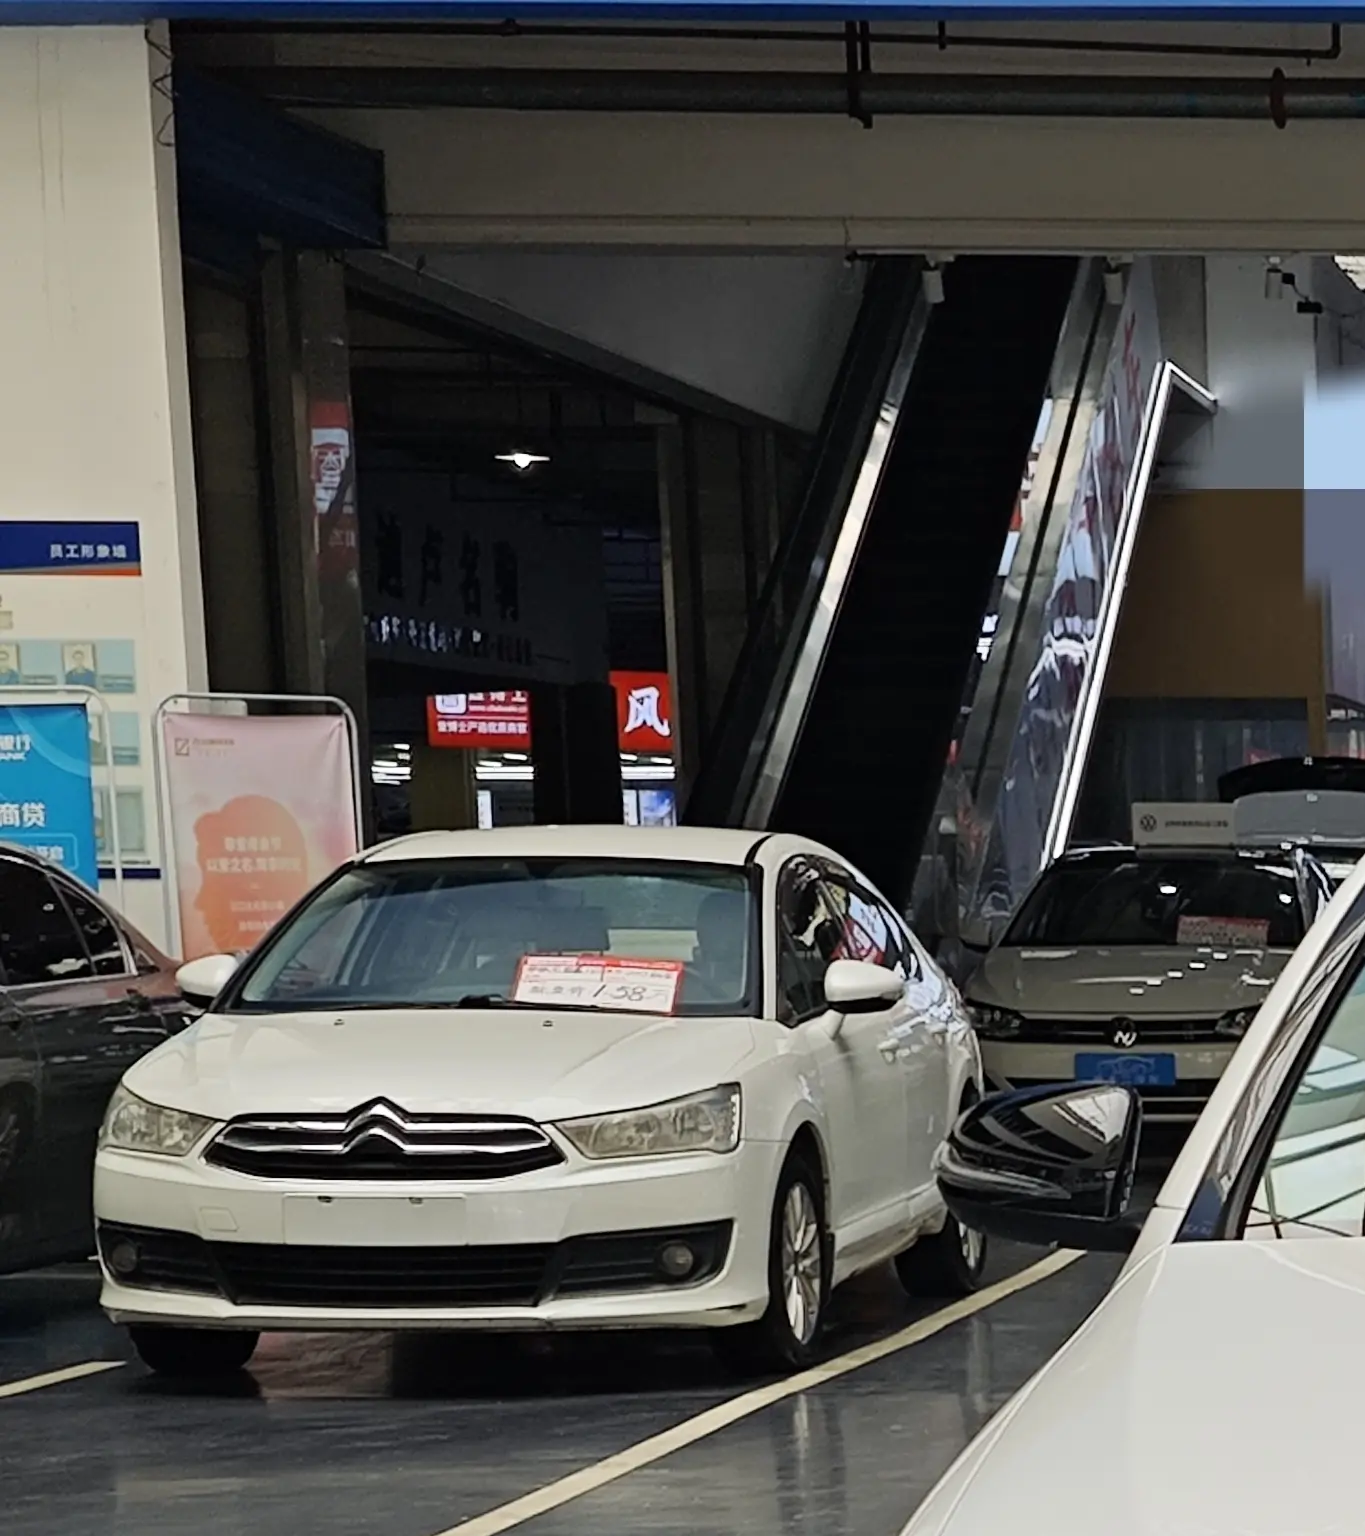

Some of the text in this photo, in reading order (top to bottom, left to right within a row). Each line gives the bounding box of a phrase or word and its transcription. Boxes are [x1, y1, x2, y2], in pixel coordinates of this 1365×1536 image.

[50, 543, 127, 559] 员工形象墙
[623, 685, 671, 738] 风
[0, 801, 46, 829] 商贷
